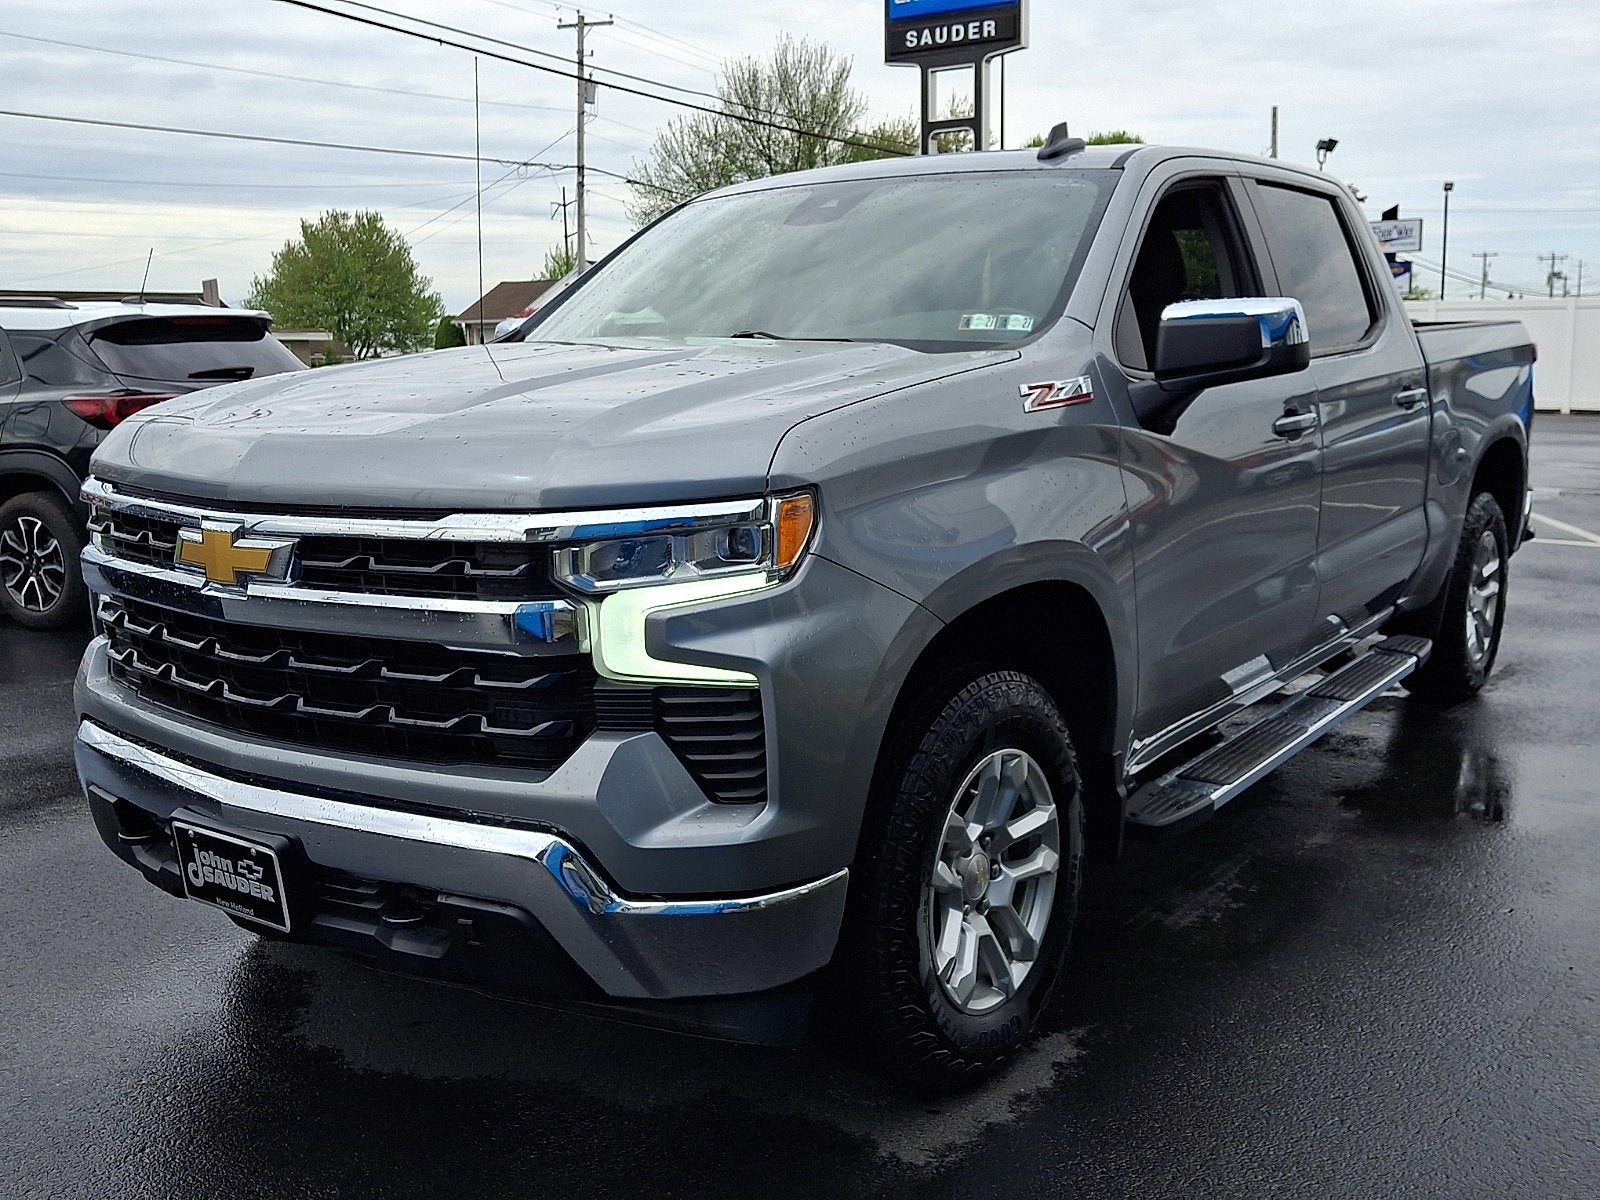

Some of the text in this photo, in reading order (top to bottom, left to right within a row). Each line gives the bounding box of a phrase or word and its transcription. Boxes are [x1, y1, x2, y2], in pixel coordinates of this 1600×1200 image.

[905, 19, 997, 48] SAUDER
[1018, 375, 1094, 414] Z71
[202, 865, 276, 903] SAUDER
[216, 896, 255, 916] New Holland
